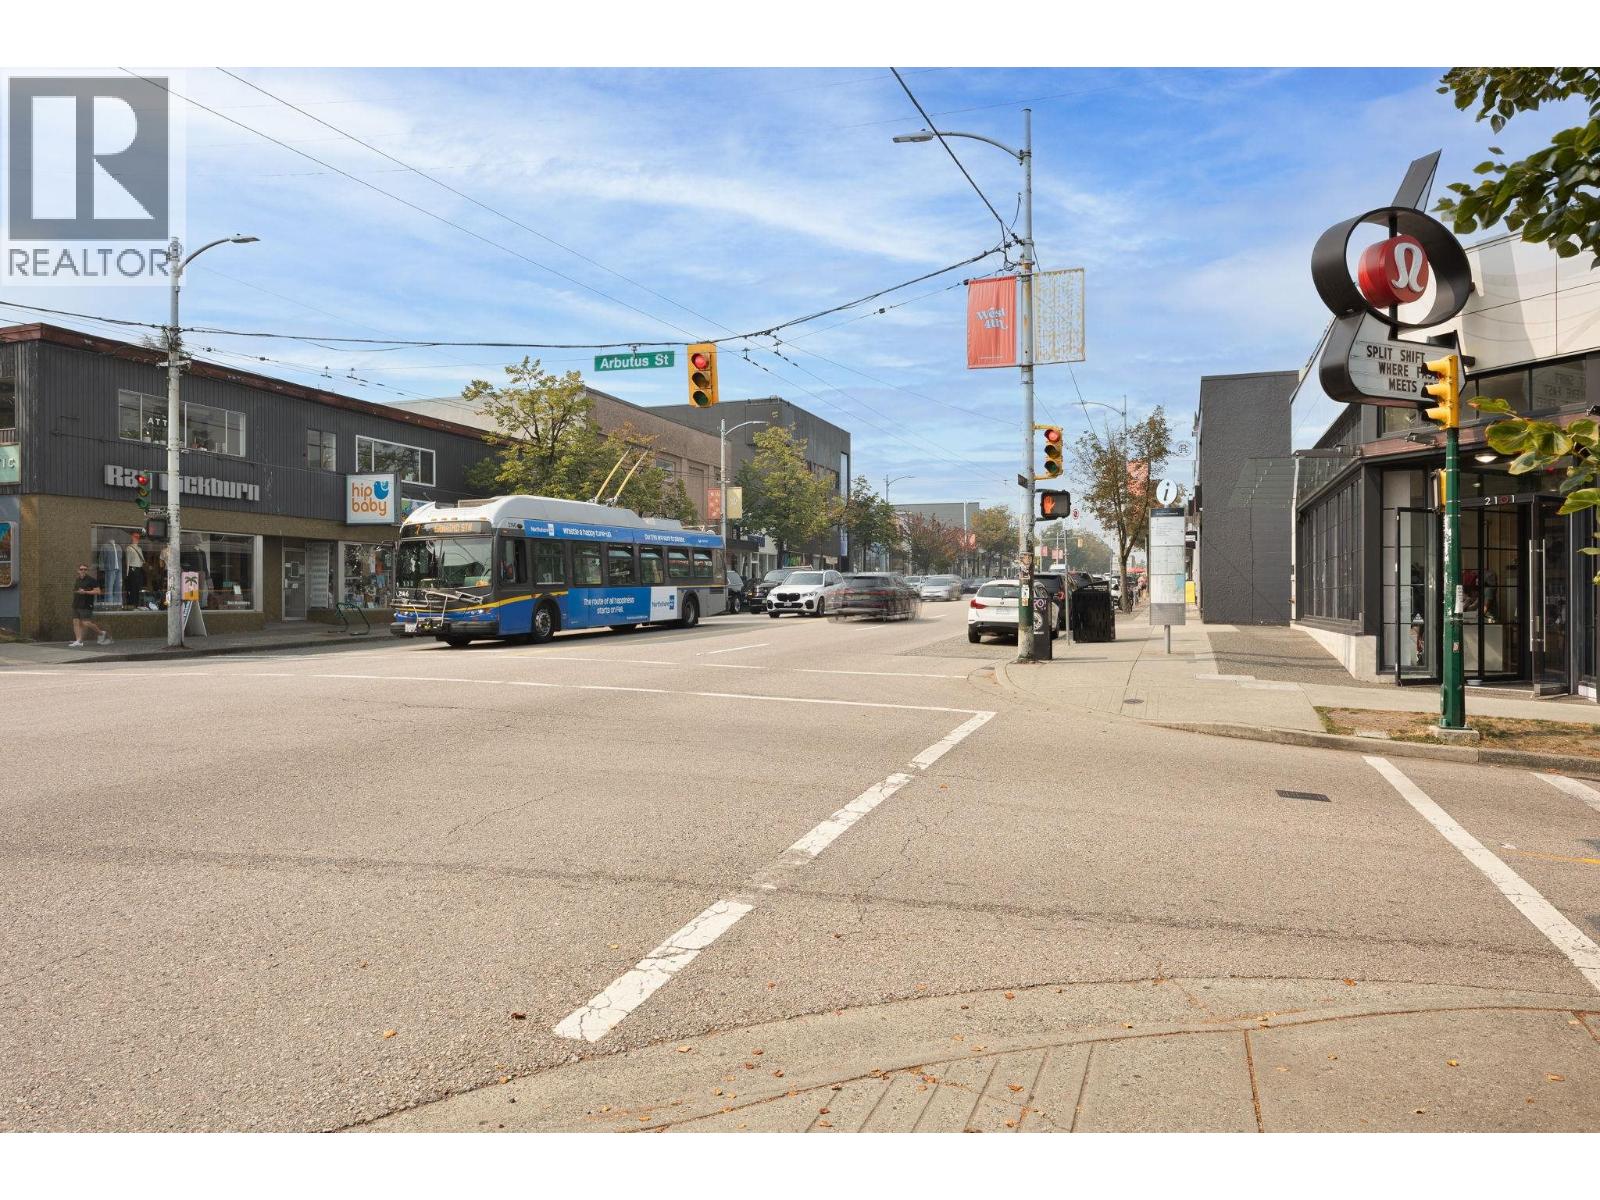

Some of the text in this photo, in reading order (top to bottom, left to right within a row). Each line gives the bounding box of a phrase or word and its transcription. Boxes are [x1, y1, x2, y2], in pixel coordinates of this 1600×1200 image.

[977, 307, 1006, 321] West
[984, 317, 1008, 330] 4th
[600, 353, 669, 369] Arbutus St
[1366, 345, 1425, 364] SPLIT SHIFT
[1379, 362, 1409, 377] WHERE
[1389, 378, 1418, 392] MEETS
[148, 417, 168, 427] ATT
[0, 456, 16, 469] IC
[352, 482, 373, 501] hip
[352, 498, 387, 516] baby
